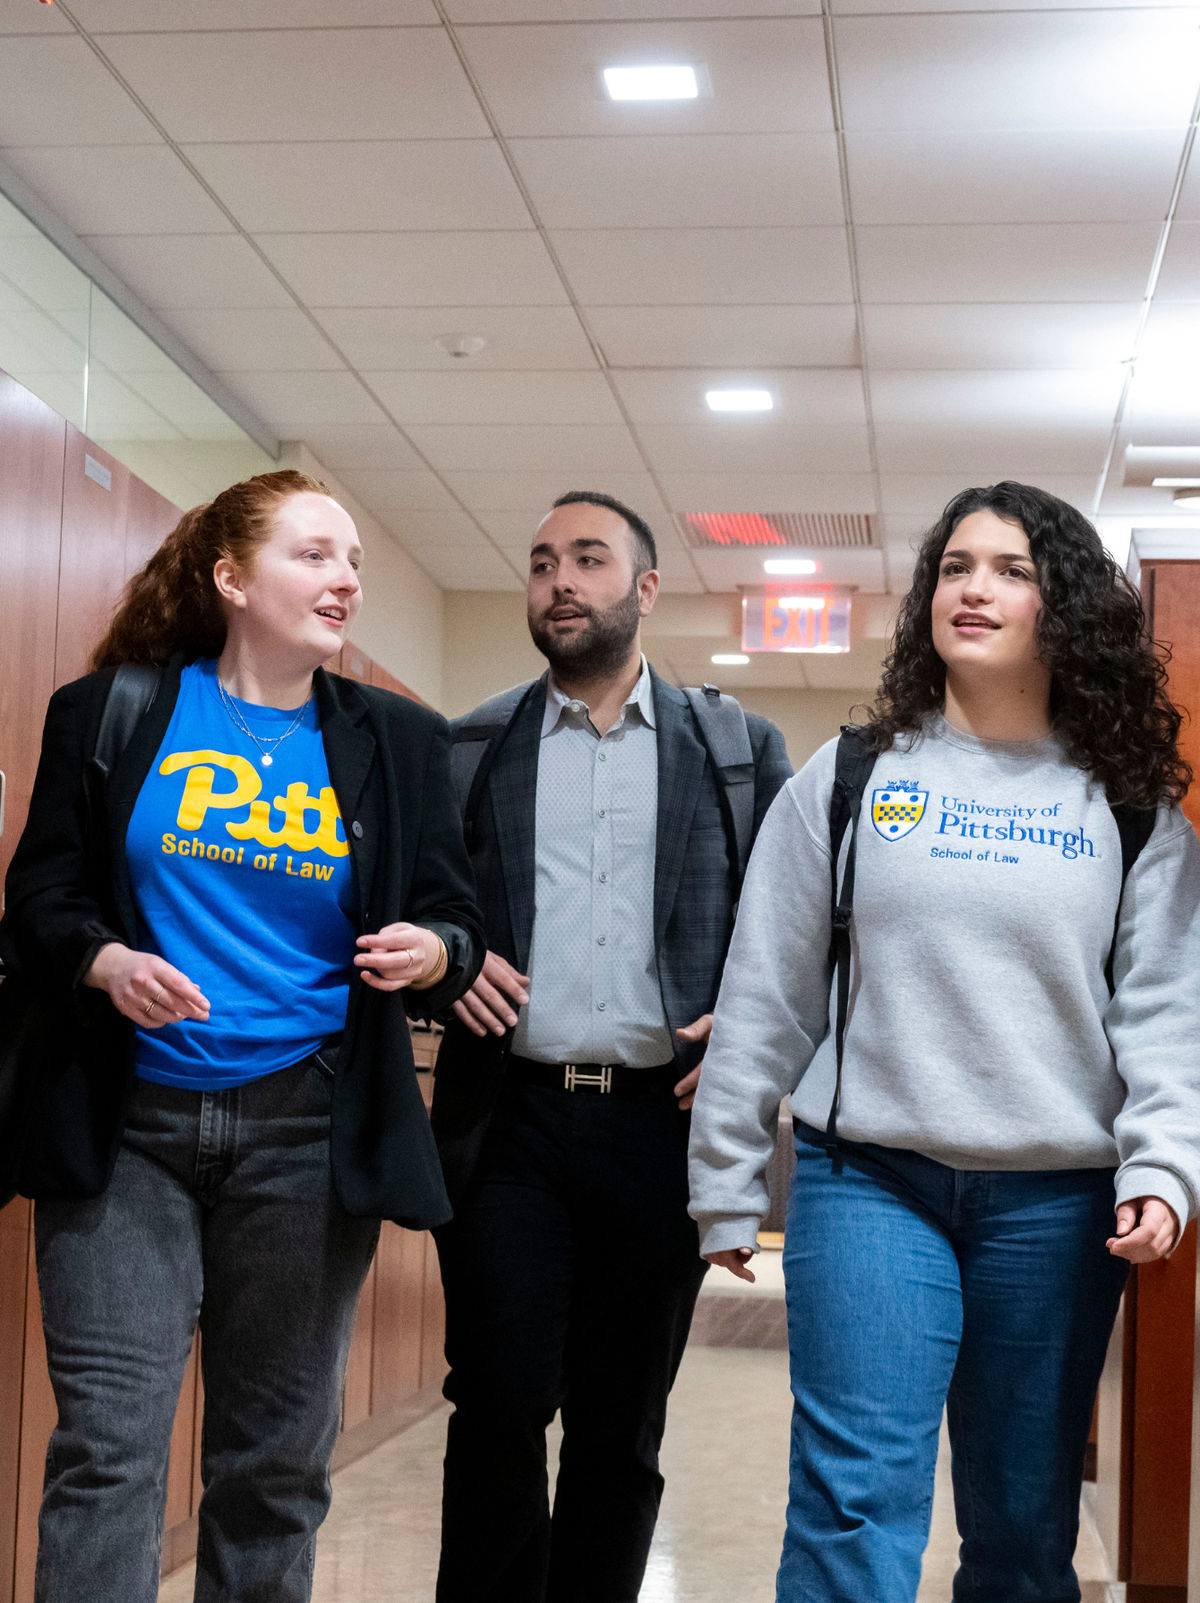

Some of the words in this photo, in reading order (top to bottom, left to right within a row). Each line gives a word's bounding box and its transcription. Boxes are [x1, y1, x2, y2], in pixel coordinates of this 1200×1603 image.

[763, 597, 835, 648] EXIT
[941, 795, 1037, 821] University
[1041, 803, 1062, 817] of
[161, 833, 245, 865] School
[253, 853, 278, 871] of
[286, 856, 335, 881] Law
[930, 847, 972, 861] School
[976, 851, 991, 862] of
[994, 853, 1020, 864] Law
[934, 811, 1096, 859] Pittsburgh
